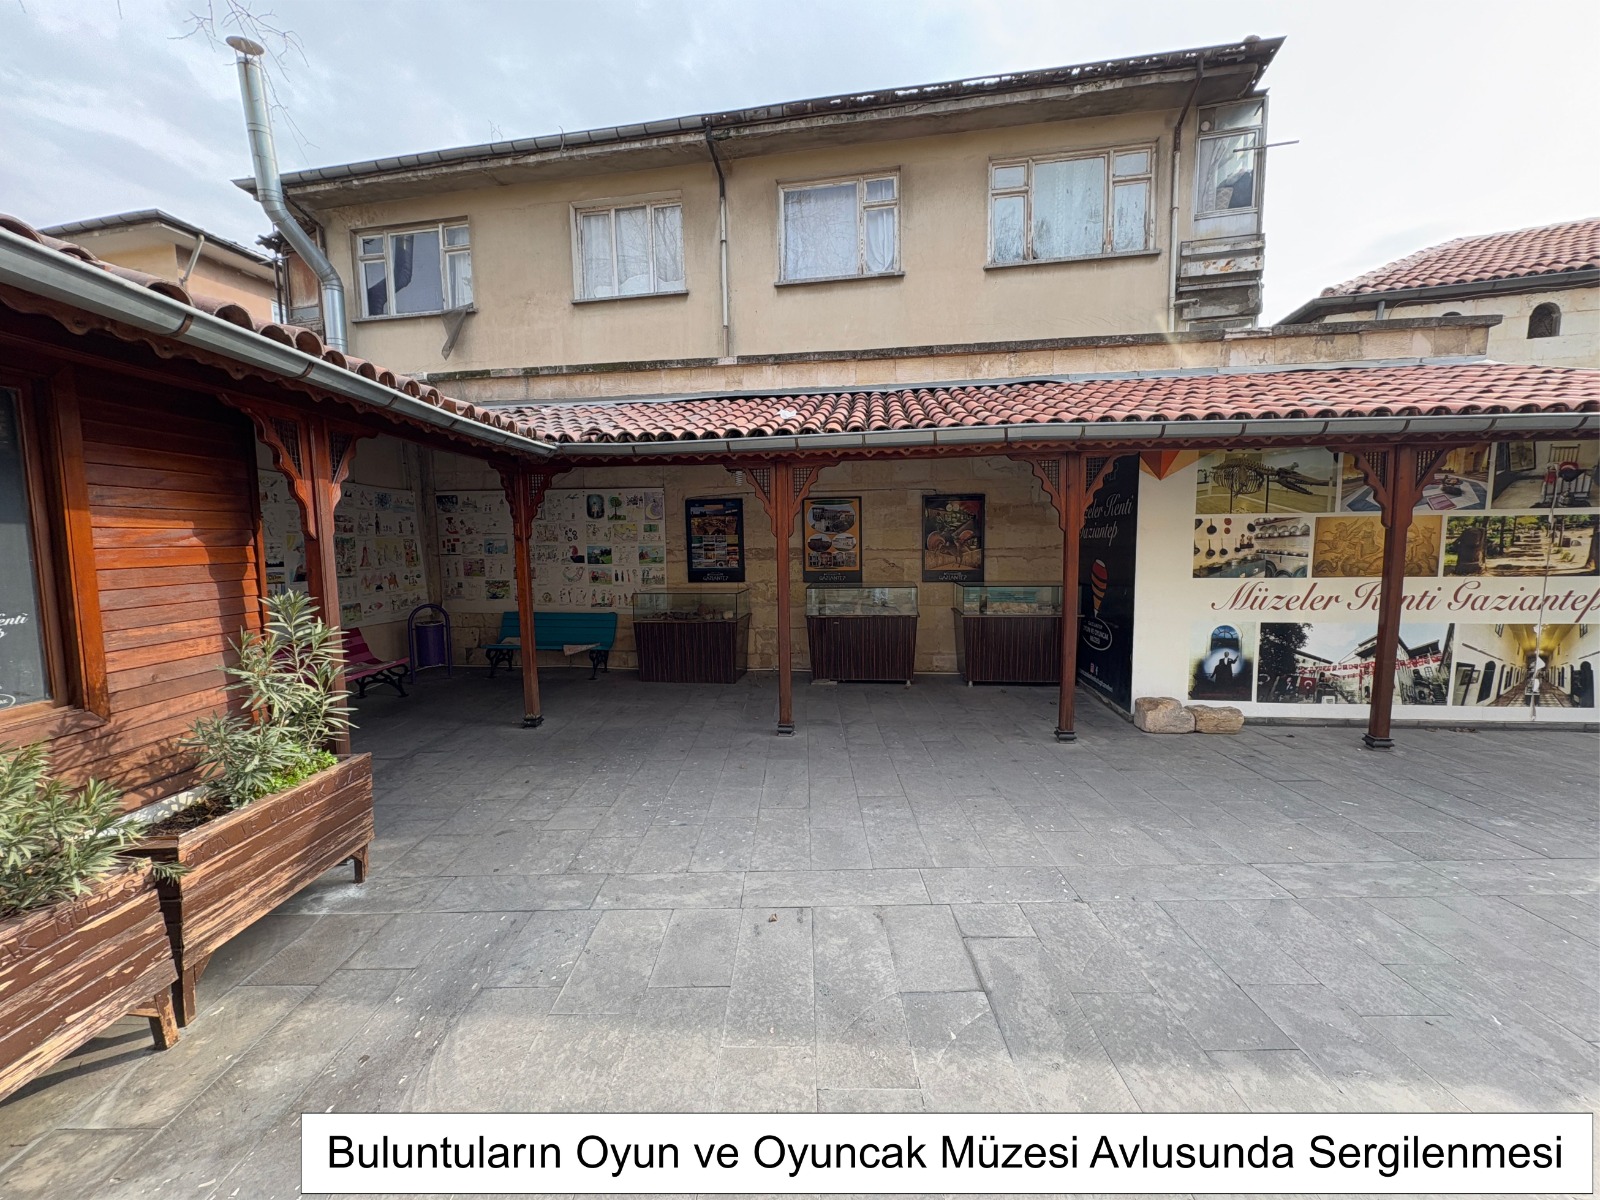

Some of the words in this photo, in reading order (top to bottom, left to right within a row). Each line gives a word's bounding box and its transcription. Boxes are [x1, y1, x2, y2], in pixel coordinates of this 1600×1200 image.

[1104, 494, 1134, 517] Kenti
[1080, 521, 1119, 547] aziantep
[1211, 581, 1342, 611] Müzeler
[1347, 581, 1442, 611] Knti
[1447, 578, 1600, 623] Gaziantep
